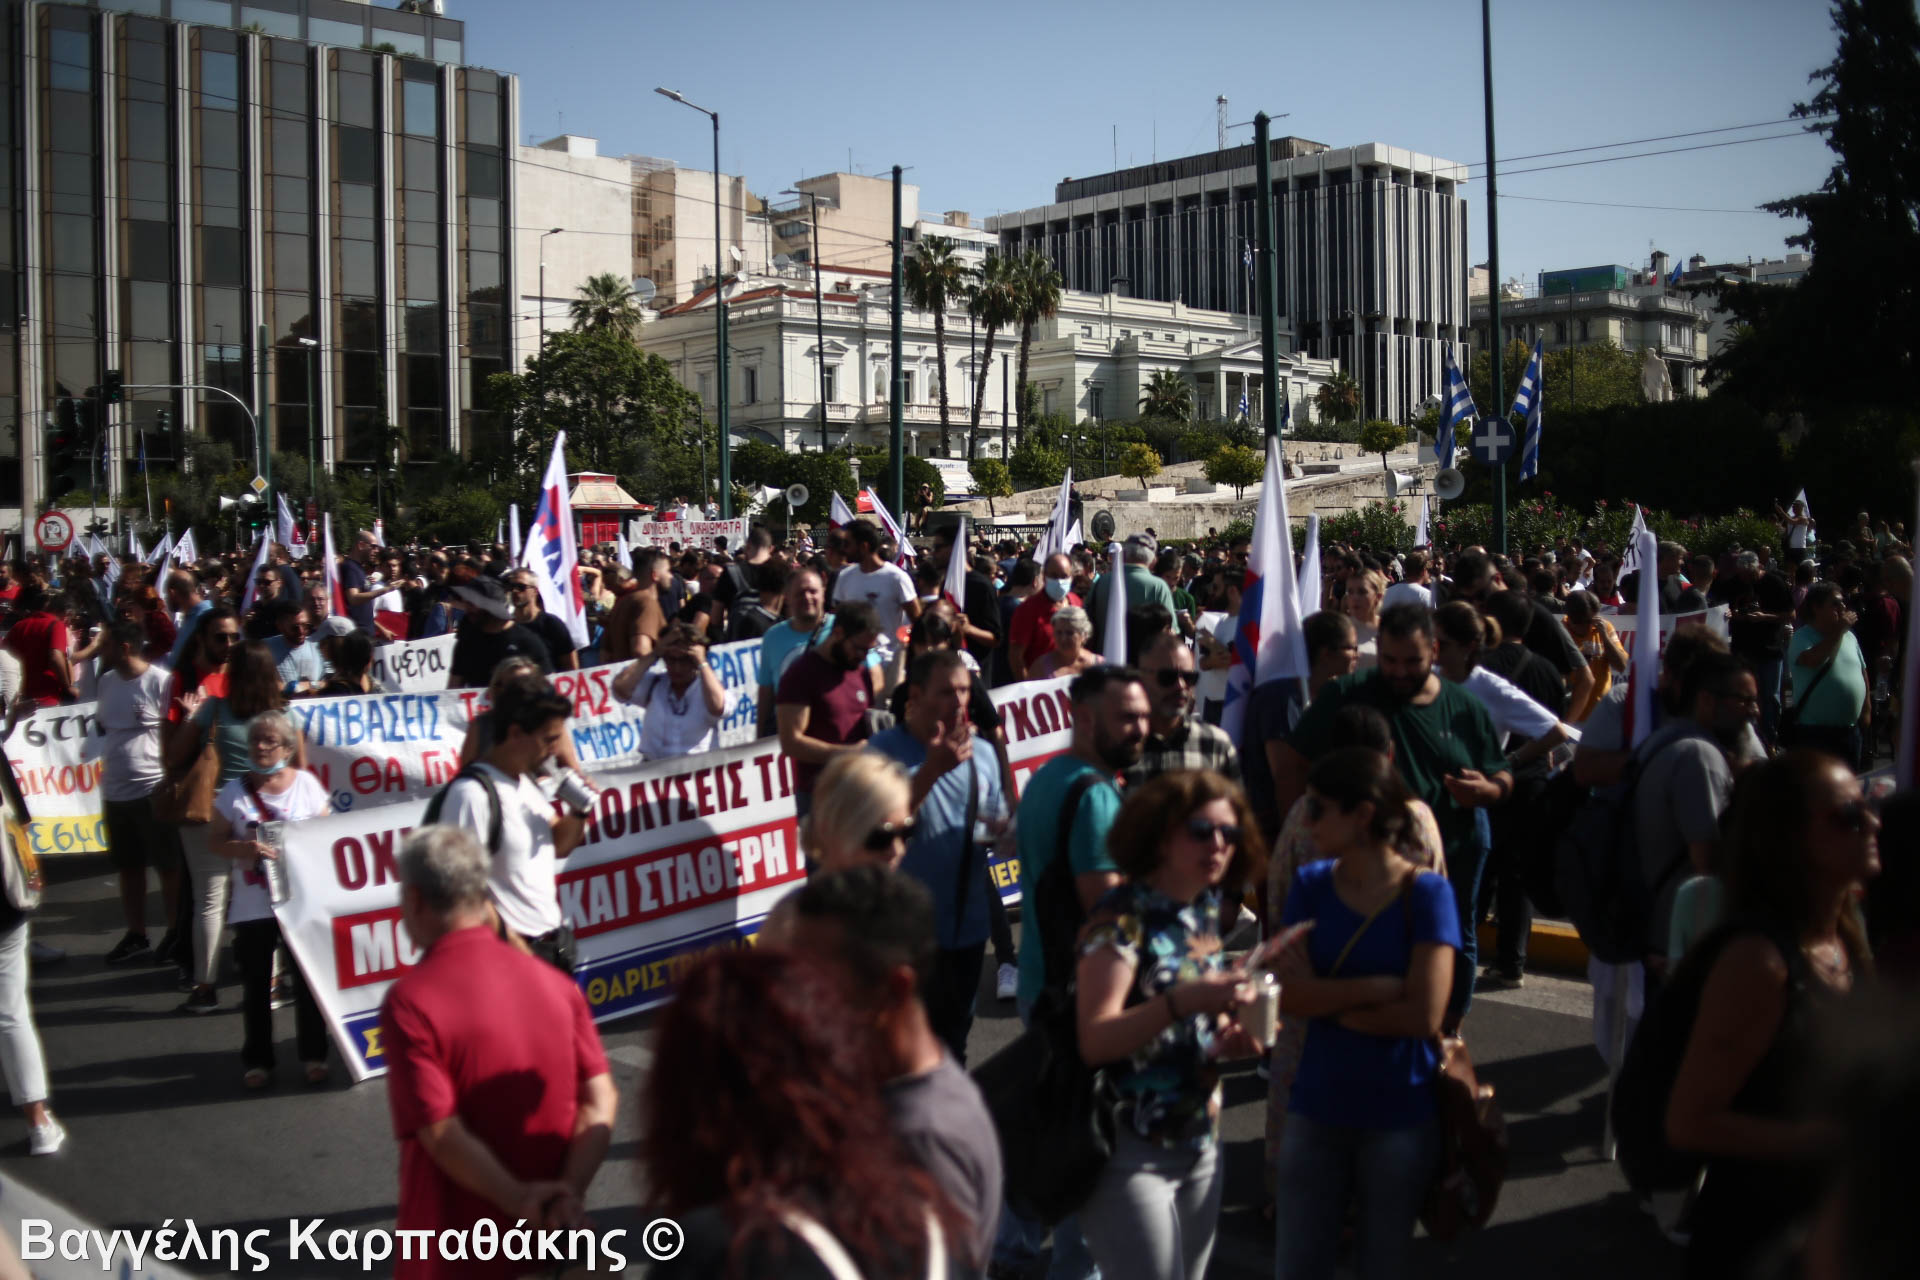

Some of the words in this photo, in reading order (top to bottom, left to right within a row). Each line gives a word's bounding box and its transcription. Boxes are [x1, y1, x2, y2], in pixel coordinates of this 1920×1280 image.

[673, 520, 684, 534] ΜΕ
[689, 520, 742, 535] ΔΙΚΑΙΩΜΑΤΑ
[350, 755, 406, 796] ΘΑ
[331, 826, 413, 892] ΟΧ
[550, 759, 749, 847] ΟΛΥΣΕΙΣ
[558, 869, 630, 929] ΚΑΙ
[634, 828, 789, 913] ΣΤΑΘΕΡΗ
